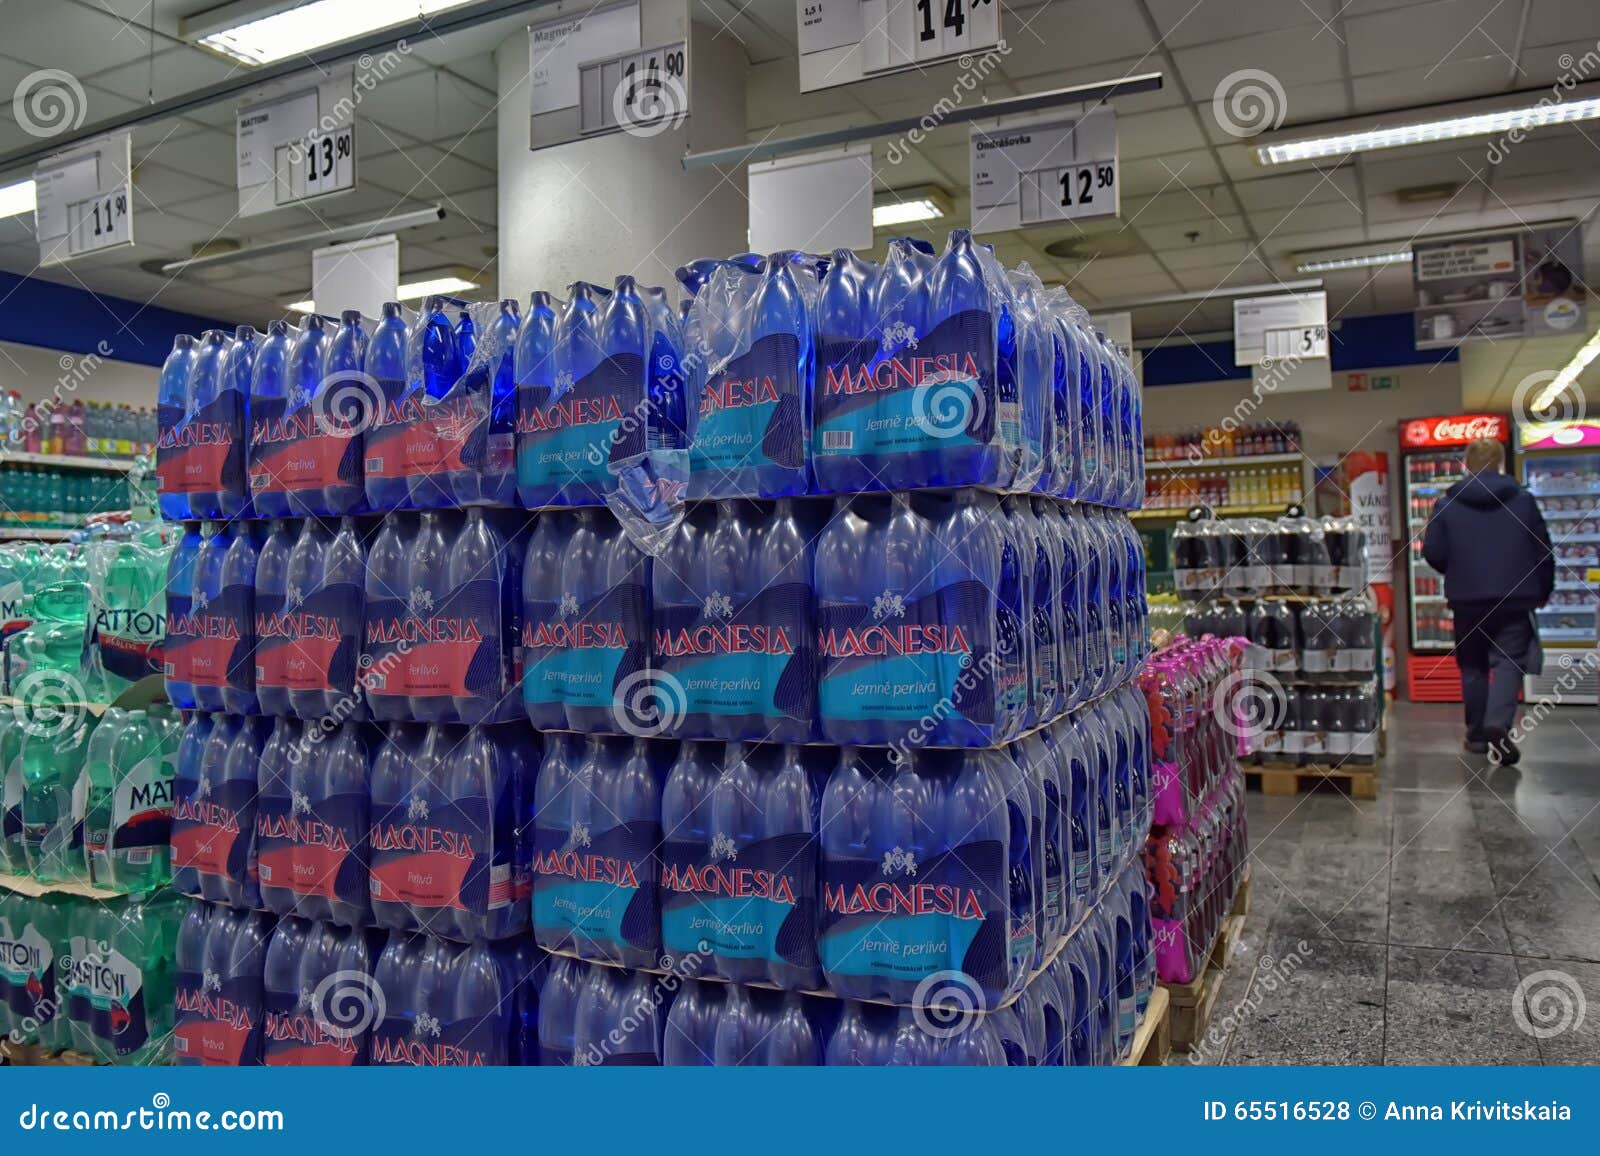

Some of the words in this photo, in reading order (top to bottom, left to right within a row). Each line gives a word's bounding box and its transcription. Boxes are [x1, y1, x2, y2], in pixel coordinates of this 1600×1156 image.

[534, 21, 582, 43] Magnesia
[917, 0, 965, 42] 14
[666, 51, 684, 80] 90
[307, 137, 334, 182] 13
[337, 133, 351, 161] 90
[1060, 168, 1094, 207] 12
[1097, 166, 1114, 189] 50
[92, 199, 114, 237] 11
[1301, 330, 1312, 352] 5
[824, 351, 981, 396] MAGNESIA
[250, 412, 354, 447] MAGNESIA
[366, 397, 480, 431] MAGNSIA
[515, 394, 624, 434] MAGNESIA
[864, 413, 901, 432] Jemně
[156, 421, 233, 450] MAGNESIA
[712, 431, 753, 449] perlivá
[165, 611, 241, 642] MANESIA
[255, 612, 342, 642] MAGNESIA
[367, 615, 483, 645] MAGNESIA
[521, 620, 629, 649] MAGNESIA
[655, 624, 795, 656] MAGNESIA
[819, 623, 973, 658] MAGNESIA
[719, 677, 761, 694] perlivá
[850, 680, 891, 696] Jemně
[892, 679, 937, 698] perlivá
[170, 795, 241, 834] MAGNESIA
[257, 811, 351, 852] MAGNESIA
[369, 821, 475, 861] MAGNESIA
[532, 848, 641, 890] MAGNESIA
[661, 863, 797, 906] MAGNESIA
[825, 881, 987, 921] MAGNESIA
[859, 939, 901, 955] Jemně
[902, 939, 948, 959] perlivá
[175, 985, 254, 1032] MANESIA
[264, 1011, 359, 1054] MAGNESIA
[373, 1034, 482, 1066] MAGNESIA
